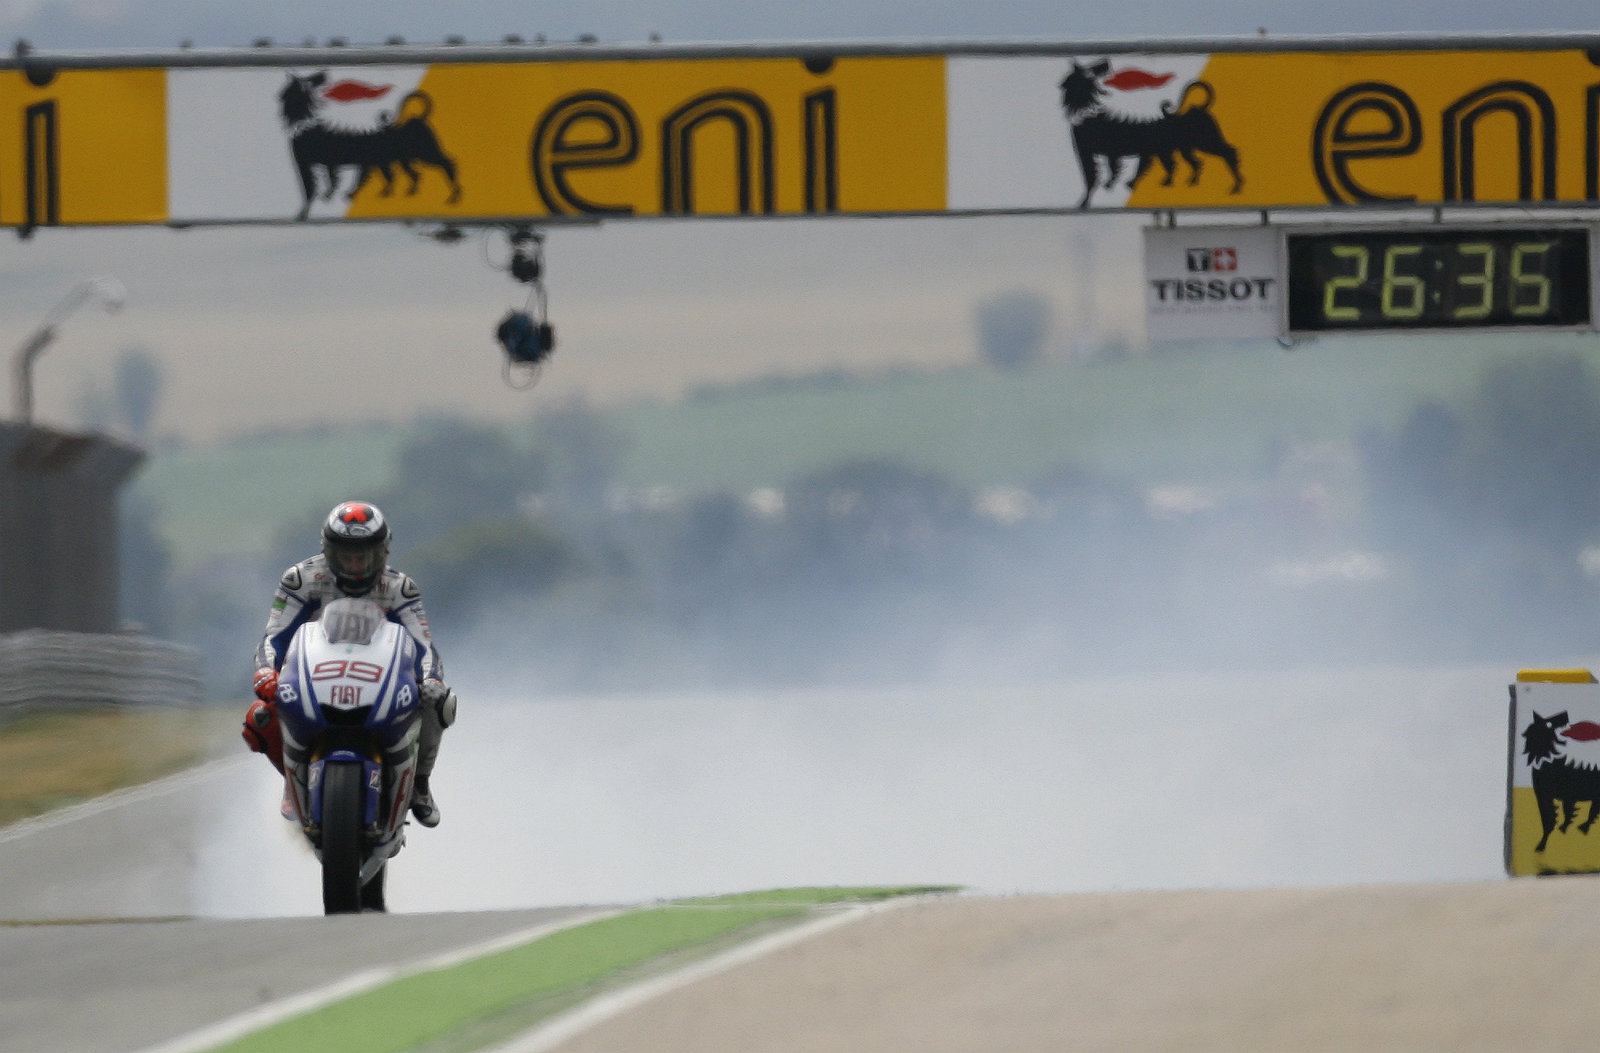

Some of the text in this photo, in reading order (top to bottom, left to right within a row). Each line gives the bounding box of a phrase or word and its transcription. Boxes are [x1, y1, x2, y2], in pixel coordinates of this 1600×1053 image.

[531, 57, 838, 216] eni
[1152, 278, 1275, 301] TISSOT
[1323, 243, 1552, 321] 26:35
[311, 660, 384, 683] 99
[330, 685, 364, 706] FIAT
